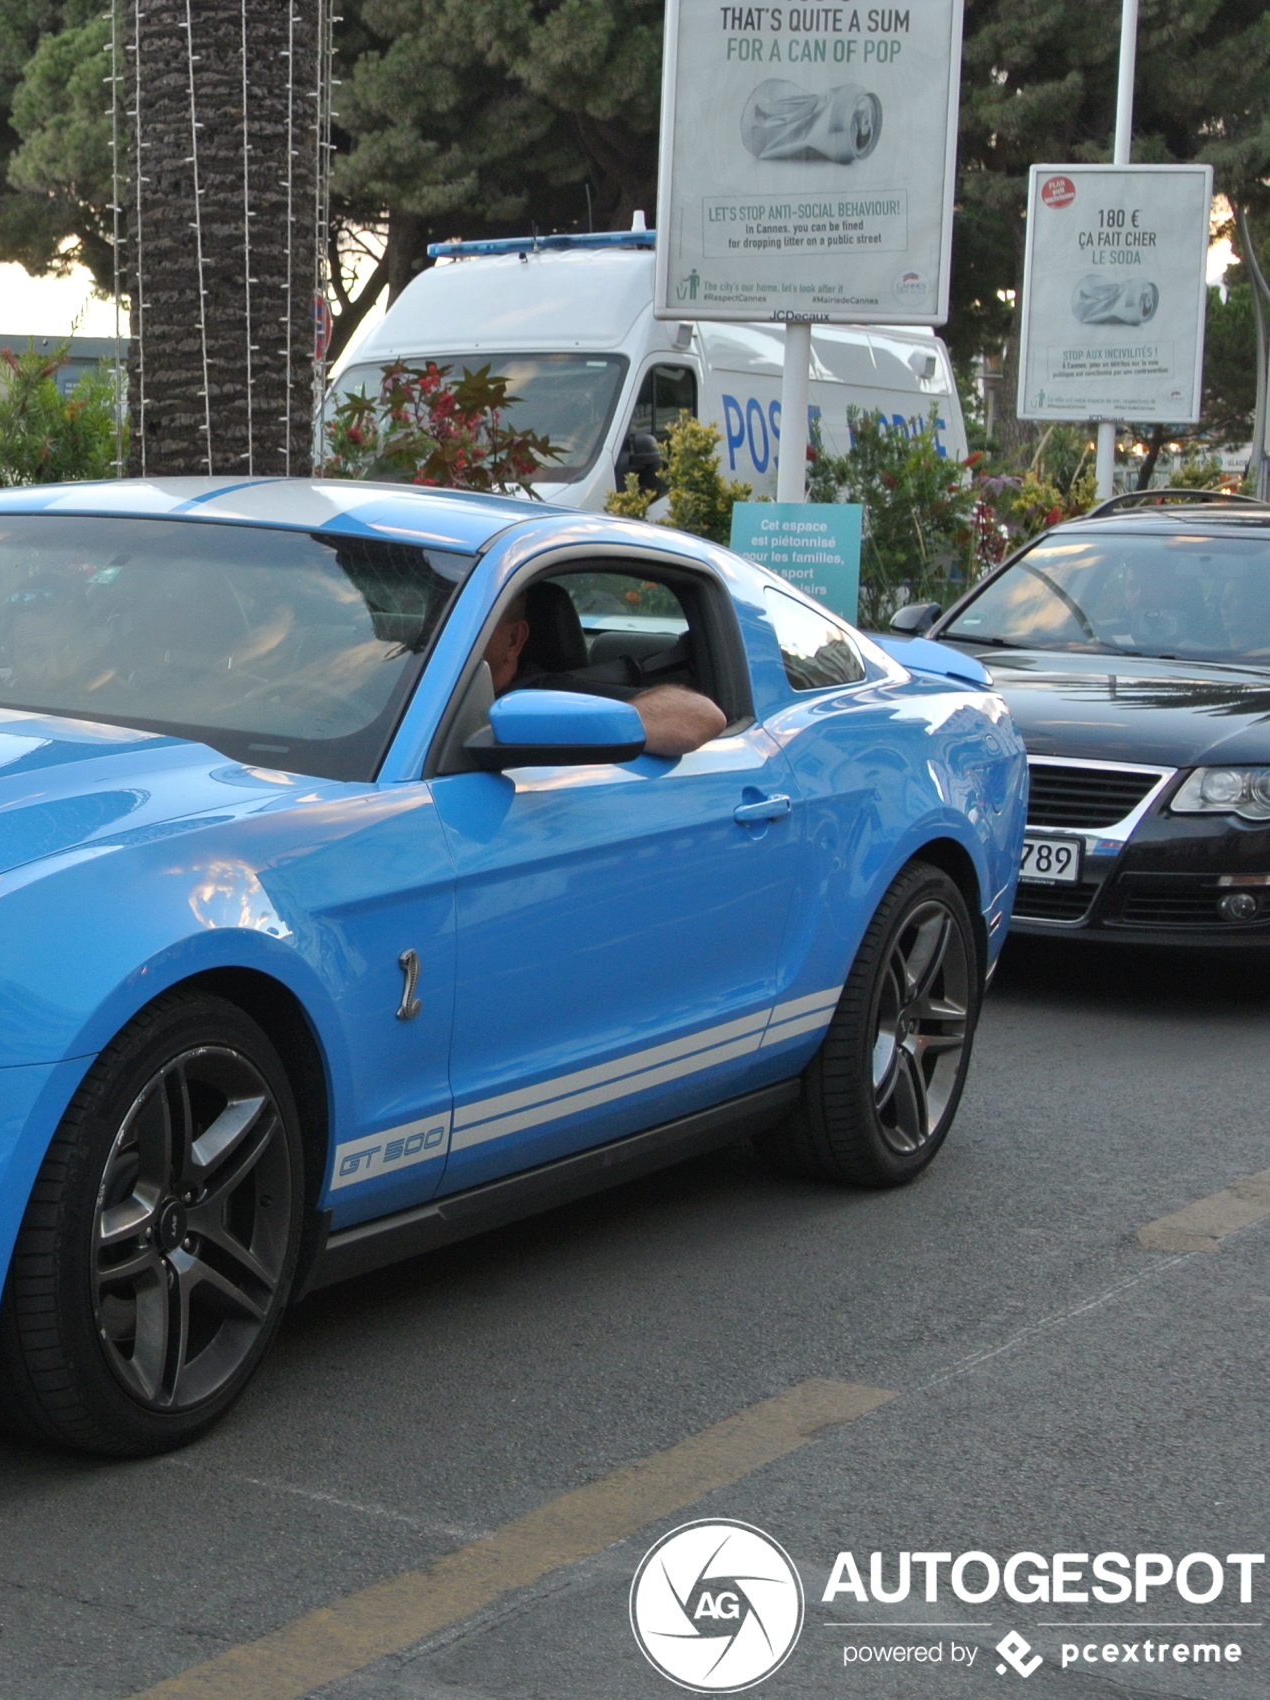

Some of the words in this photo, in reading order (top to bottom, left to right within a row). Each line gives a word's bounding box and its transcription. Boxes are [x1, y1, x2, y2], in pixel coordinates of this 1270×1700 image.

[720, 7, 782, 32] THAT'S
[788, 8, 843, 32] QUITE
[848, 9, 861, 33] A
[867, 9, 910, 33] SUM
[727, 38, 763, 62] FOR
[769, 38, 781, 62] A
[788, 39, 826, 62] CAN
[833, 39, 857, 63] OF
[864, 40, 901, 63] POP
[709, 206, 737, 222] LET'S
[739, 205, 766, 221] STOP
[768, 203, 835, 220] ANTI-SOCIAL
[838, 200, 900, 218] BEHAVIOUR!
[1099, 209, 1126, 228] 180
[745, 224, 754, 234] In
[793, 223, 808, 235] you
[811, 223, 827, 232] can
[829, 220, 840, 232] be
[842, 219, 864, 231] fined
[728, 236, 740, 248] for
[743, 237, 781, 250] dropping
[784, 235, 804, 246] litter
[806, 236, 817, 246] on
[819, 236, 825, 246] a
[827, 233, 853, 248] public
[856, 232, 882, 244] street
[1078, 232, 1094, 250] ÇA
[1097, 232, 1122, 246] FAIT
[1125, 232, 1157, 246] CHER
[1092, 250, 1106, 265] LE
[1109, 250, 1141, 265] SODA
[704, 281, 717, 291] The
[741, 284, 754, 292] our
[799, 284, 816, 293] look
[818, 284, 836, 293] after
[704, 293, 767, 303] #RespectCannes
[770, 310, 830, 321] JCDecaux
[1063, 350, 1083, 361] STOP
[1086, 349, 1103, 360] AUX
[1105, 345, 1153, 359] INCIVILITÉS
[761, 520, 779, 531] Cet
[782, 522, 828, 534] espace
[751, 535, 769, 547] est
[771, 535, 837, 549] piétonnisé
[771, 551, 788, 562] les
[792, 551, 845, 565] familles,
[781, 568, 814, 580] sport
[339, 1145, 382, 1177] GT
[382, 1126, 445, 1163] 500
